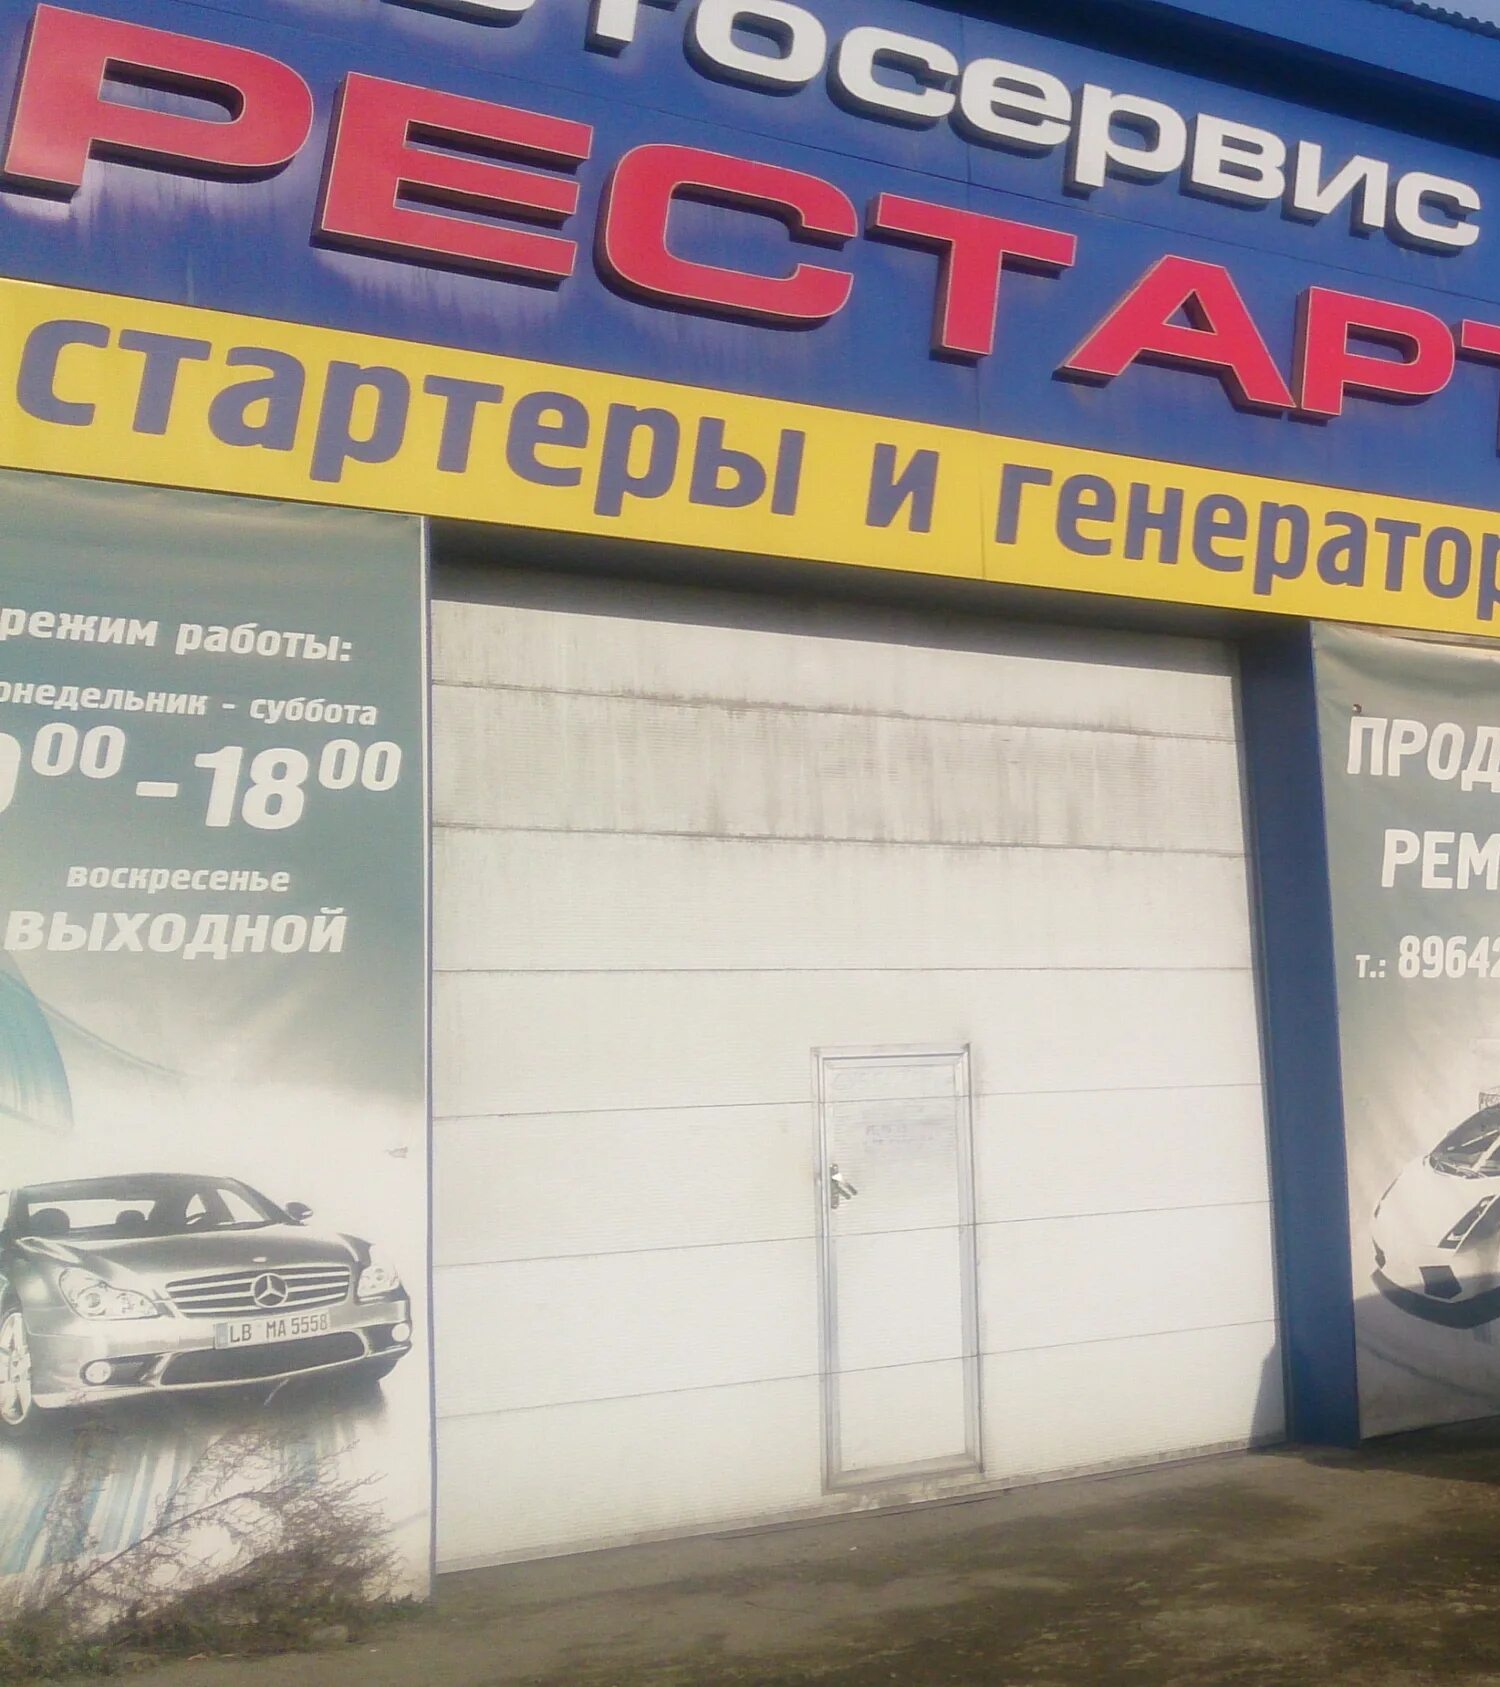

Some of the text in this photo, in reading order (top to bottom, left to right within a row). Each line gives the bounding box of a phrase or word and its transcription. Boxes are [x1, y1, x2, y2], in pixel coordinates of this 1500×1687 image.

[370, 0, 1482, 248] осервис
[15, 318, 806, 517] стартеры
[865, 443, 940, 533] и
[0, 608, 353, 662] режим работы:
[249, 696, 379, 726] суббота
[66, 865, 291, 894] воскресенье
[229, 1312, 329, 1344] LB MA 5558
